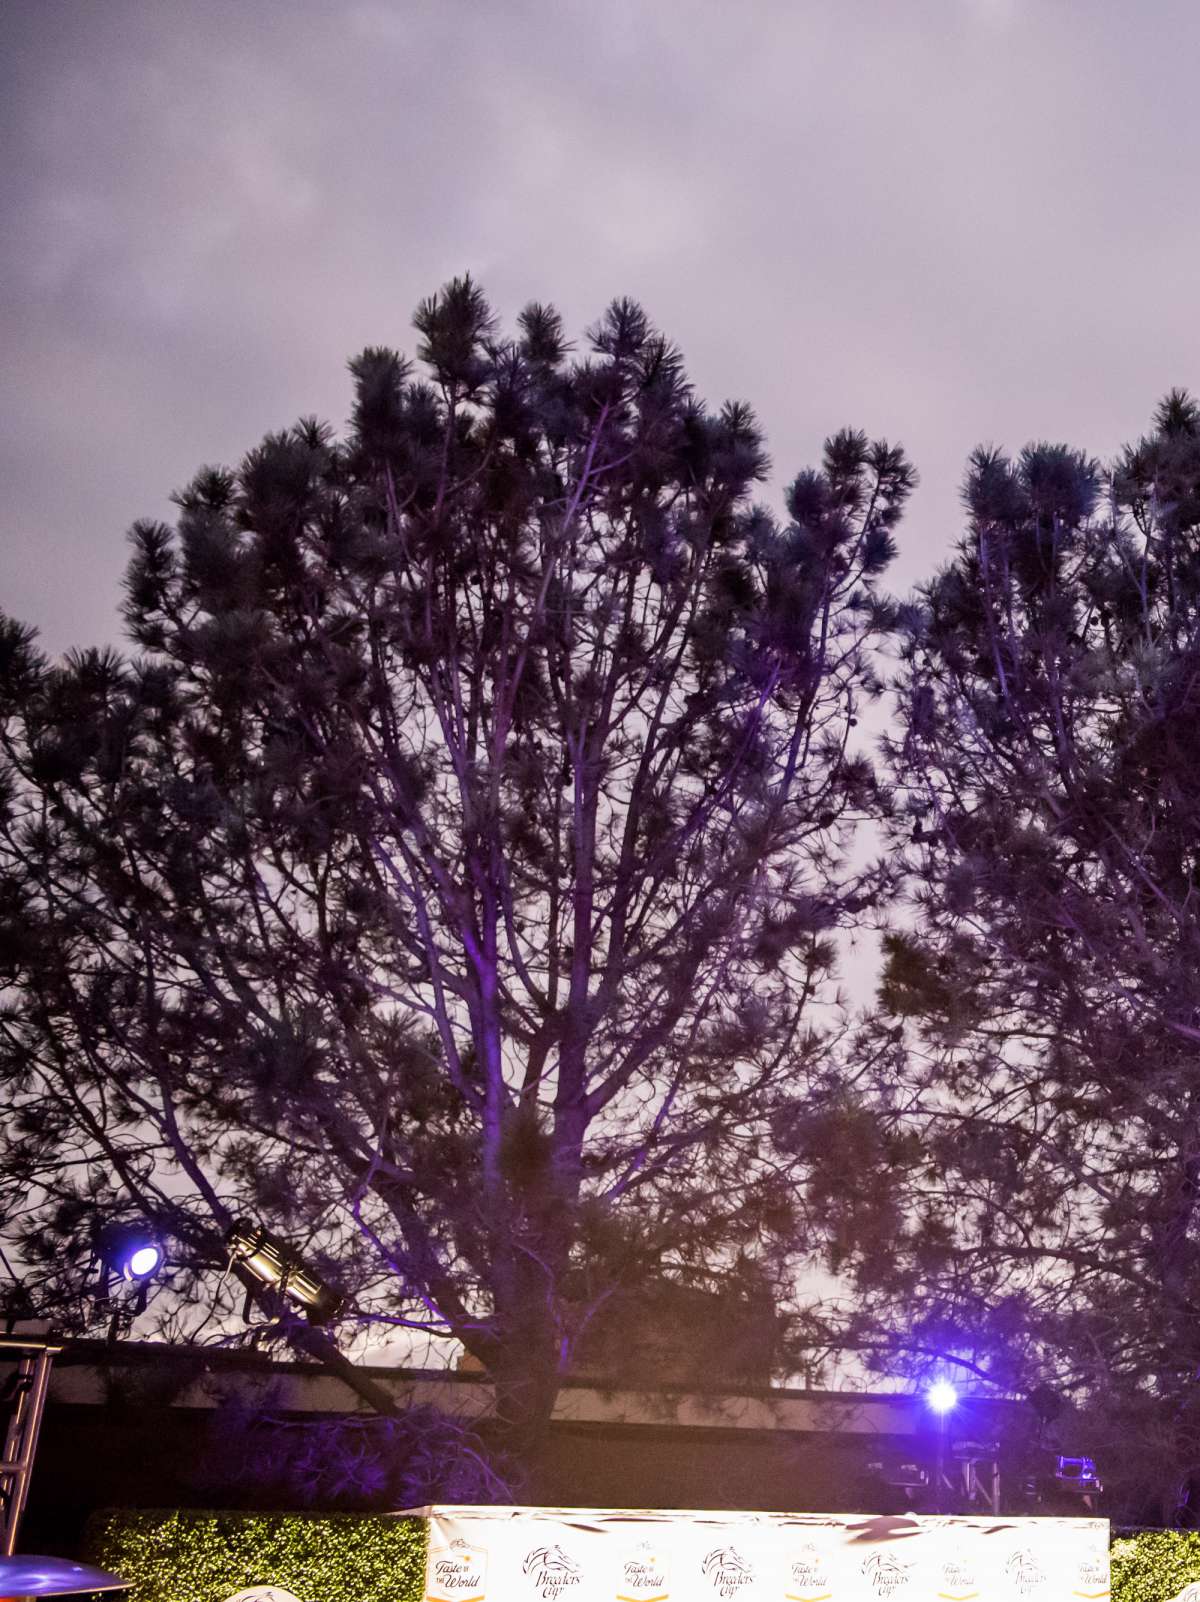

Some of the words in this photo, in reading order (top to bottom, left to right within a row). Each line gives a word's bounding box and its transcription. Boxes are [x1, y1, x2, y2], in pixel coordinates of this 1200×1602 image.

[435, 1560, 463, 1575] Taste
[624, 1561, 647, 1575] Taste
[445, 1574, 481, 1588] World
[632, 1574, 665, 1588] World
